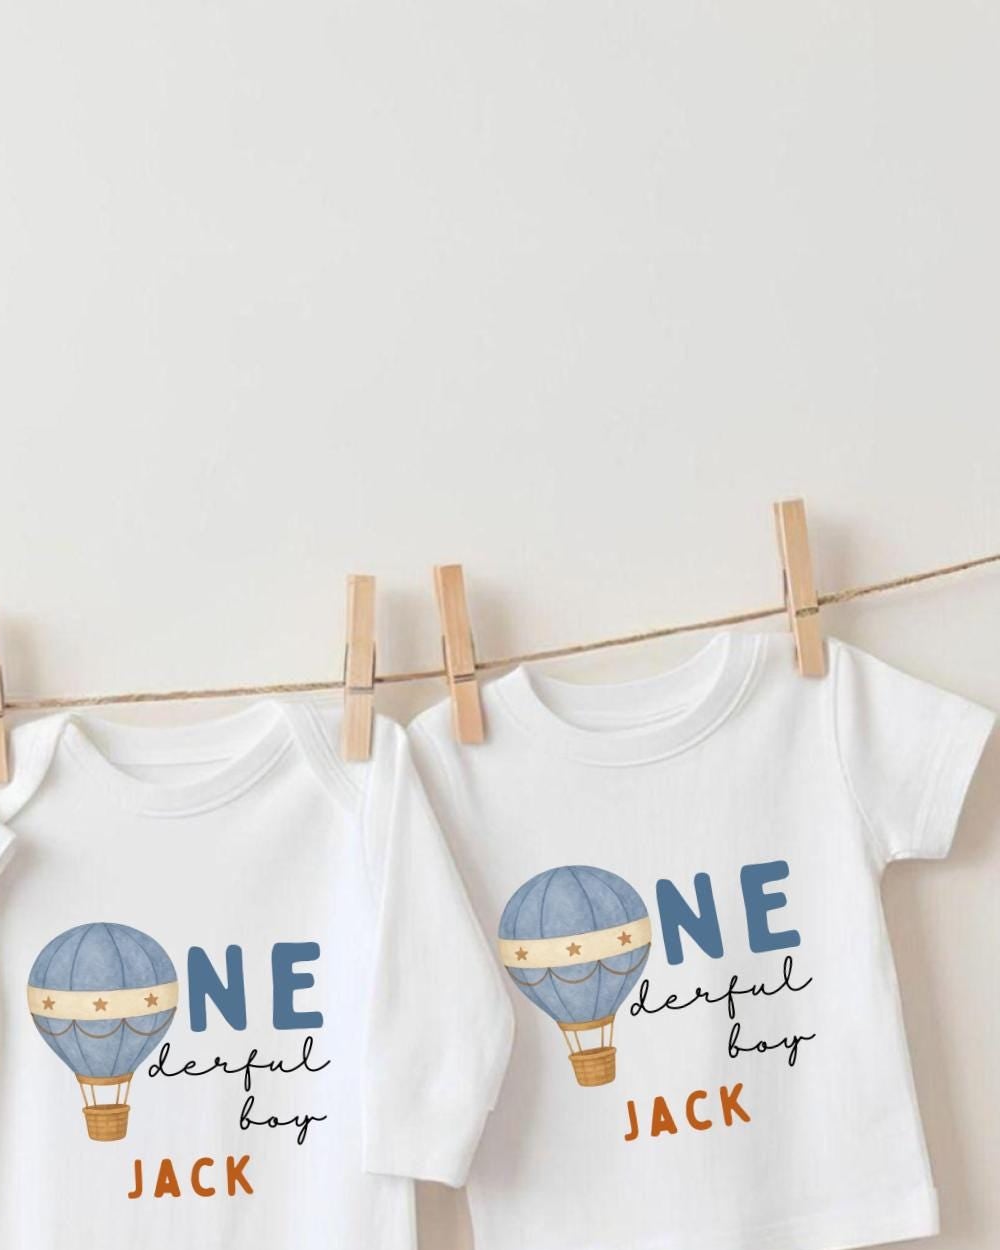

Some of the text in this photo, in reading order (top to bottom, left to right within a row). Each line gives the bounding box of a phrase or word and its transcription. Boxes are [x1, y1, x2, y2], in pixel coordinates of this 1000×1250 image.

[629, 955, 813, 1020] derful
[148, 1035, 331, 1093] derful
[727, 1022, 817, 1068] boy
[239, 1095, 328, 1146] boy
[624, 1082, 751, 1142] JACK
[127, 1154, 254, 1200] JACK
